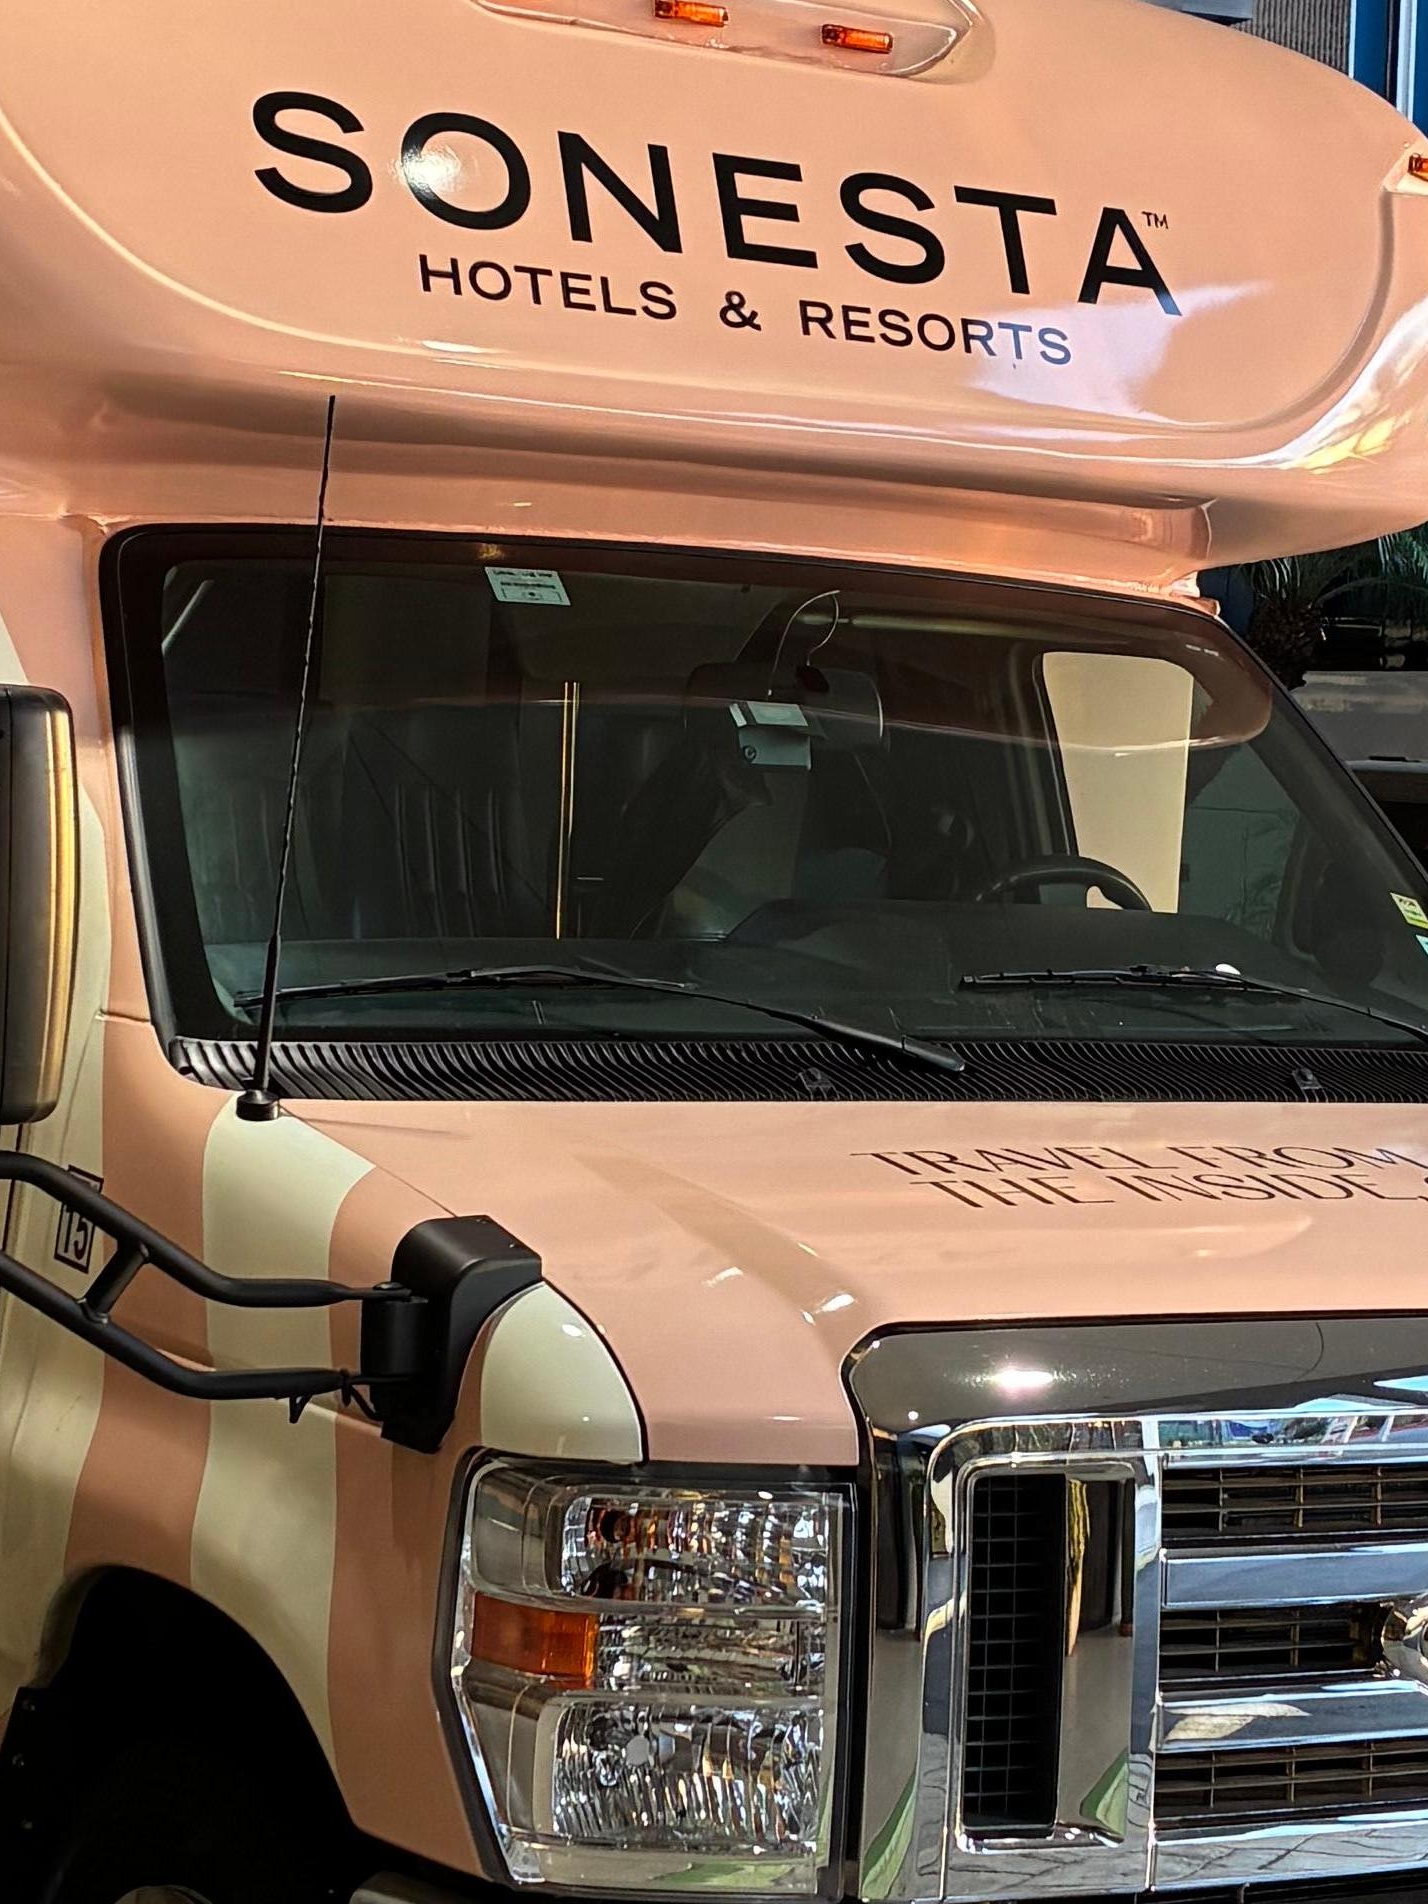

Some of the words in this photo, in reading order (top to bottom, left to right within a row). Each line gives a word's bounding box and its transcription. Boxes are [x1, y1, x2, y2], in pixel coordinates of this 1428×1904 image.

[250, 90, 1182, 317] SONESTA
[419, 253, 677, 322] HOTELS
[719, 290, 762, 332] &
[798, 298, 1072, 366] RESORTS
[849, 1146, 1179, 1176] TRAVEL
[909, 1175, 1116, 1209] THE
